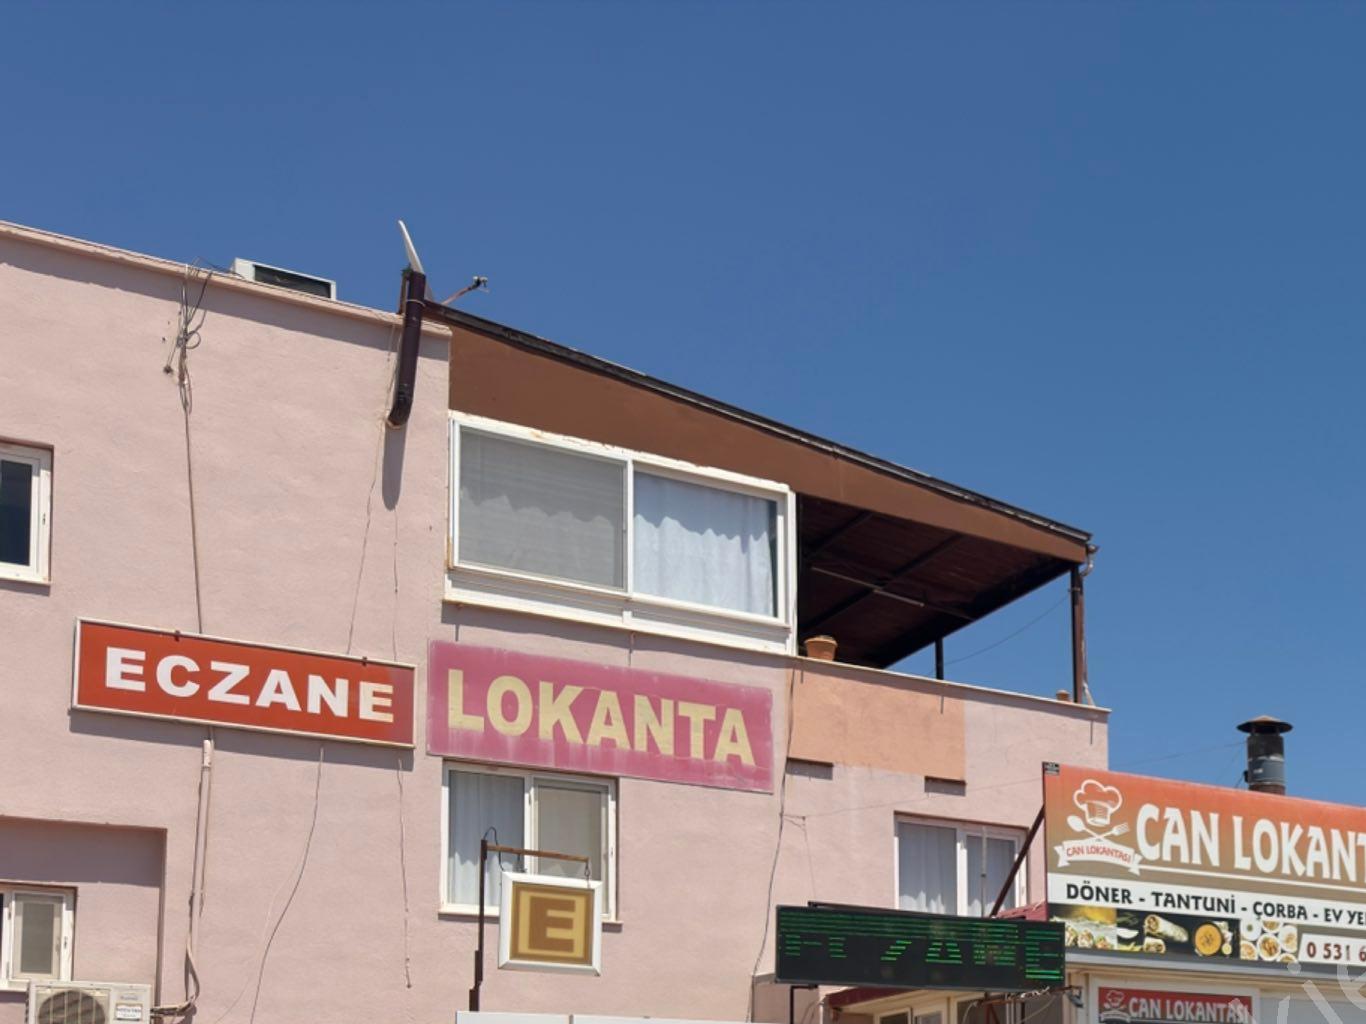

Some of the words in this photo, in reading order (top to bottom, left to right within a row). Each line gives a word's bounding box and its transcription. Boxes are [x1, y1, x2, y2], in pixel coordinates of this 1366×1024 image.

[106, 645, 394, 723] ECZANE
[447, 668, 756, 767] LOKANTA
[1066, 847, 1085, 857] CAN
[1136, 803, 1220, 867] CAN
[527, 896, 576, 953] E
[1066, 880, 1133, 904] DÖNER
[1151, 890, 1236, 914] TANTUNİ
[1253, 901, 1308, 921] ÇORBA
[1324, 907, 1343, 923] EV
[1306, 941, 1317, 958] 0
[1323, 943, 1350, 961] 531
[1128, 997, 1161, 1019] CAN
